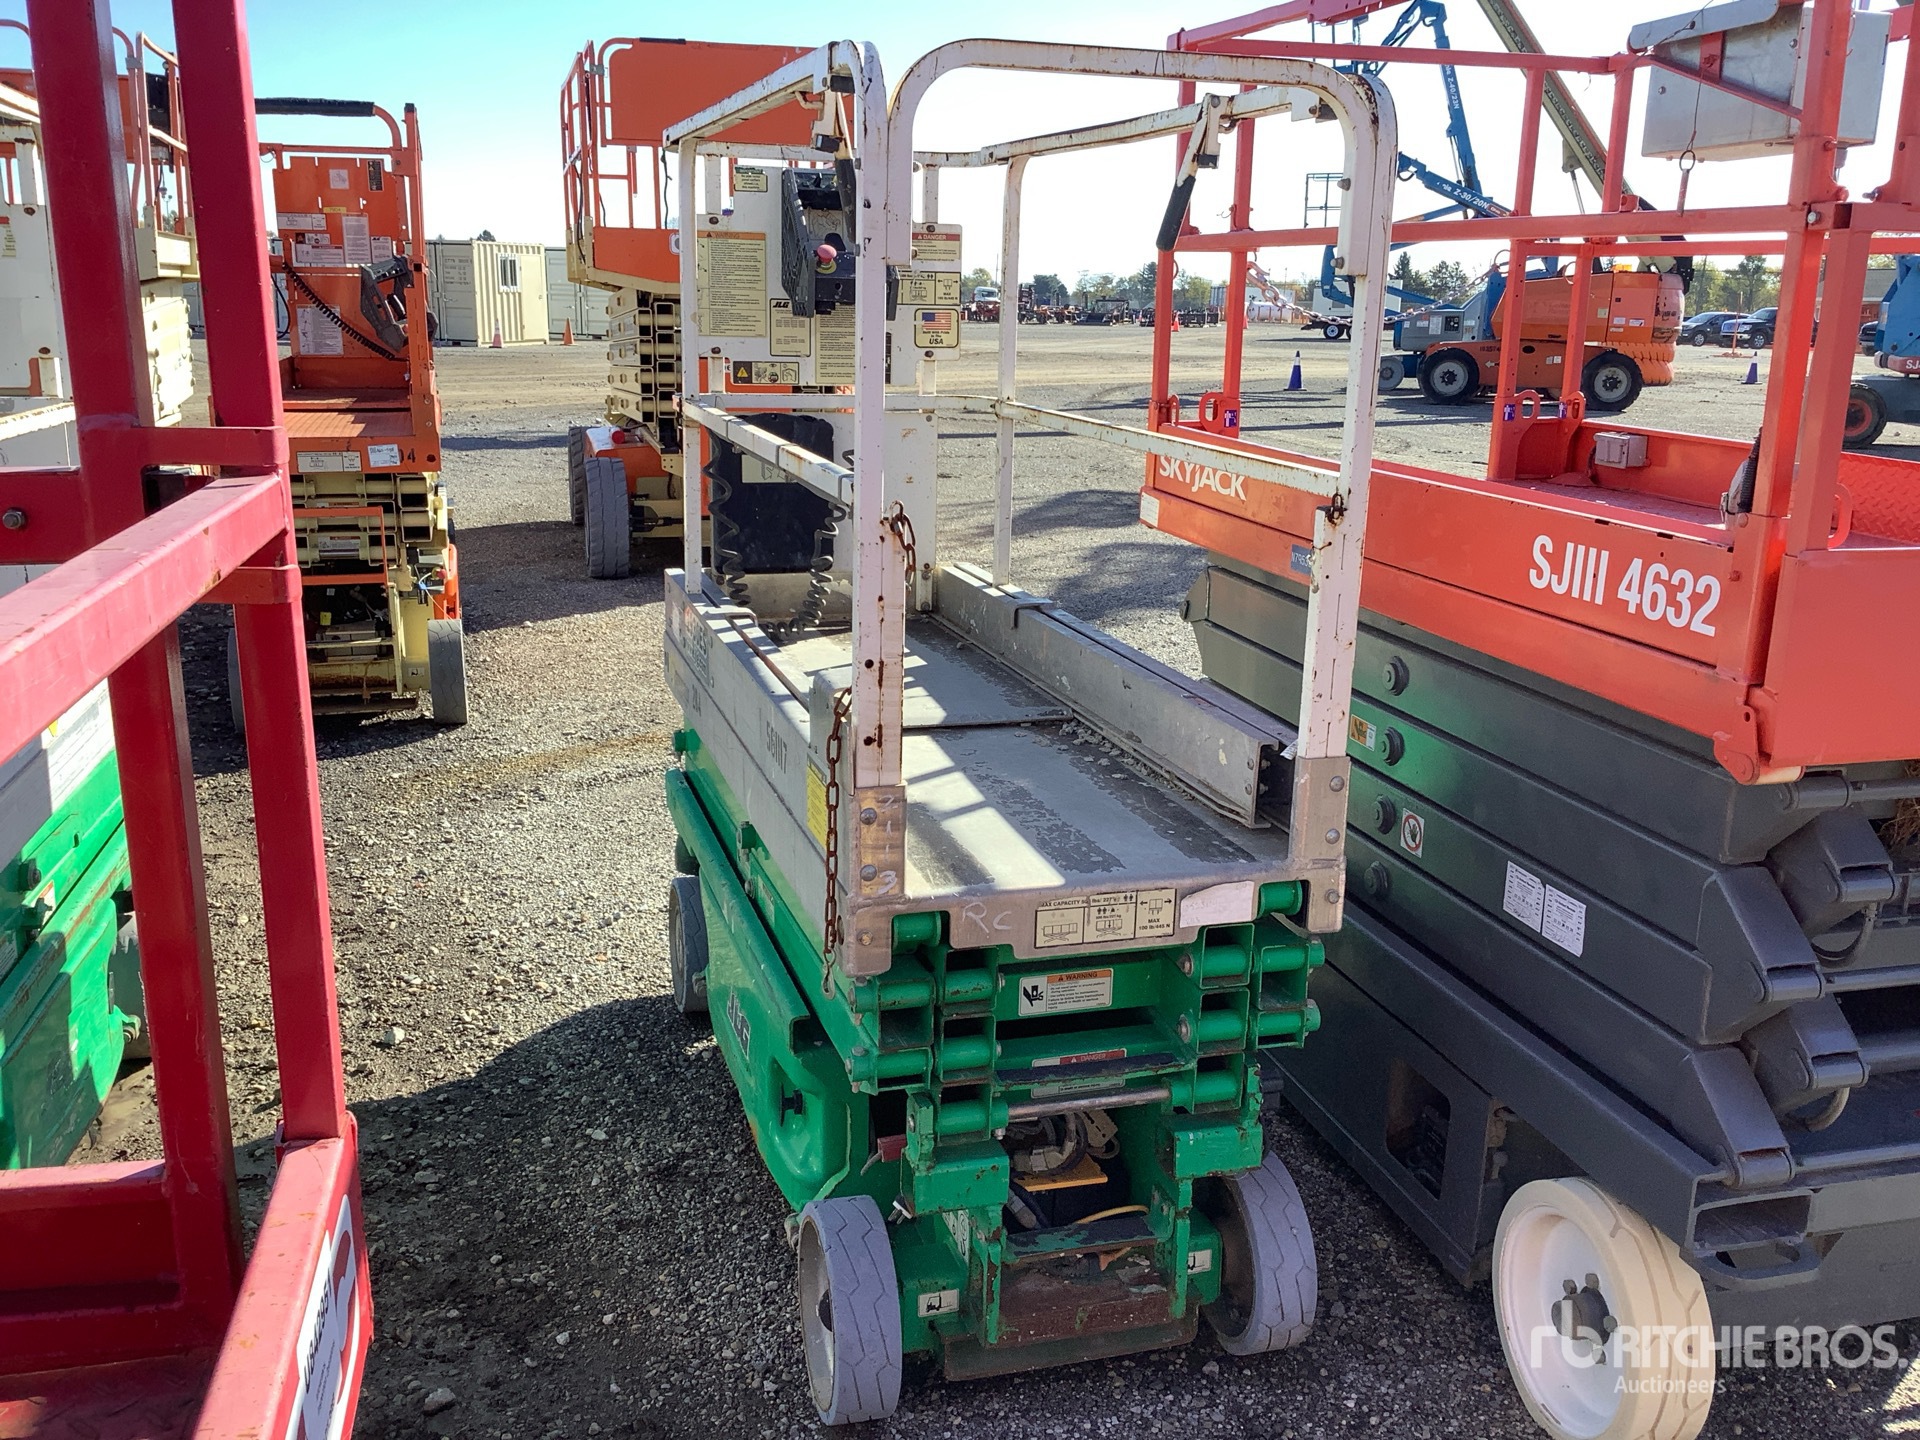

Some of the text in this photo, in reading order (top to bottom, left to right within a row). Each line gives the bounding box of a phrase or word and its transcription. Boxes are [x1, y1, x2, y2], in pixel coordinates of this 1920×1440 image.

[1453, 188, 1490, 210] Z-30/20N
[772, 301, 790, 309] JLG
[1906, 359, 1920, 370] SJ
[1159, 455, 1247, 502] SKYJACK
[1529, 534, 1721, 637] SJIII 4632
[1053, 899, 1080, 907] CAPACITY
[961, 901, 1013, 935] RC
[1065, 971, 1098, 980] WARNING
[1080, 1053, 1107, 1062] DANGER
